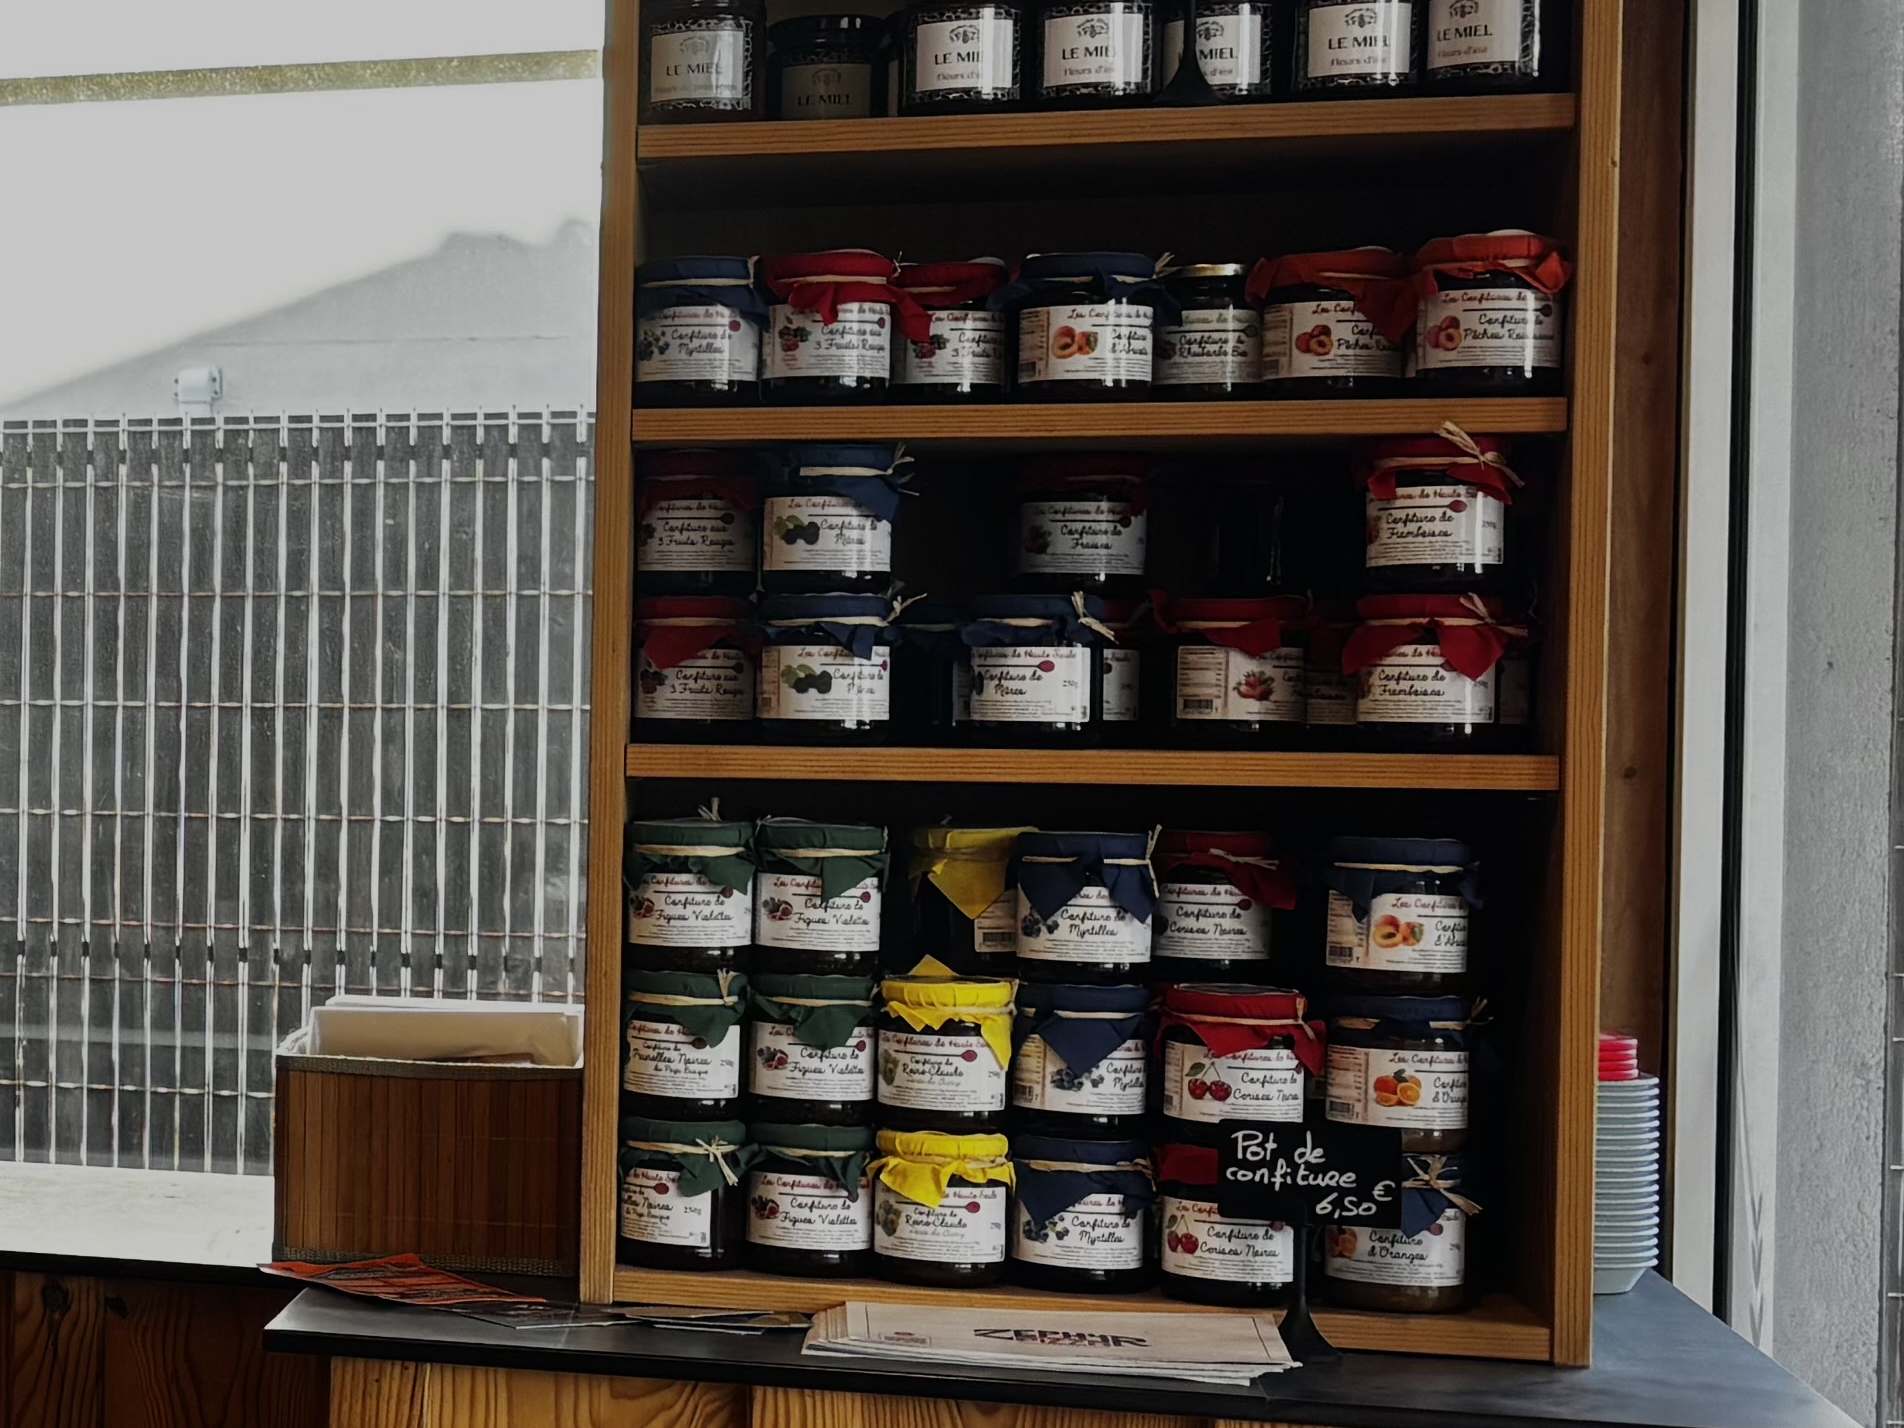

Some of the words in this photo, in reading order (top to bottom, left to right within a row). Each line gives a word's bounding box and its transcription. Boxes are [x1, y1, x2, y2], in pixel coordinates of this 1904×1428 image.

[1437, 29, 1452, 42] LE
[1454, 24, 1493, 38] MIEL
[1327, 36, 1348, 50] LE
[934, 53, 952, 65] LE
[1062, 47, 1079, 61] LE
[666, 65, 681, 77] LE
[798, 95, 812, 106] LE
[819, 93, 852, 106] MIEL
[1386, 512, 1437, 528] Confiture
[1438, 510, 1455, 522] de
[1060, 524, 1109, 540] Confiture
[1378, 669, 1429, 685] Confiture
[1431, 669, 1446, 682] de
[663, 894, 713, 910] Confiture
[714, 895, 726, 907] de
[804, 898, 853, 914] Confiture
[653, 910, 690, 926] Figues
[792, 912, 830, 930] Figues
[1060, 907, 1112, 924] Confiture
[1175, 904, 1229, 921] Confiture
[1068, 922, 1119, 939] Myrtilles
[800, 1046, 849, 1063] Confiture
[789, 1059, 827, 1077] Figues
[1241, 1071, 1289, 1090] Confiture
[1230, 1130, 1278, 1162] Pot
[1293, 1129, 1327, 1165] de
[1225, 1157, 1358, 1192] confiture
[789, 1197, 838, 1213] Confiture
[779, 1211, 815, 1227] Figues
[1071, 1215, 1119, 1232] Confiture
[1078, 1230, 1126, 1246] Myrtilles
[1207, 1225, 1260, 1243] Confiture
[1262, 1229, 1275, 1241] de
[1368, 1230, 1424, 1249] Confiture
